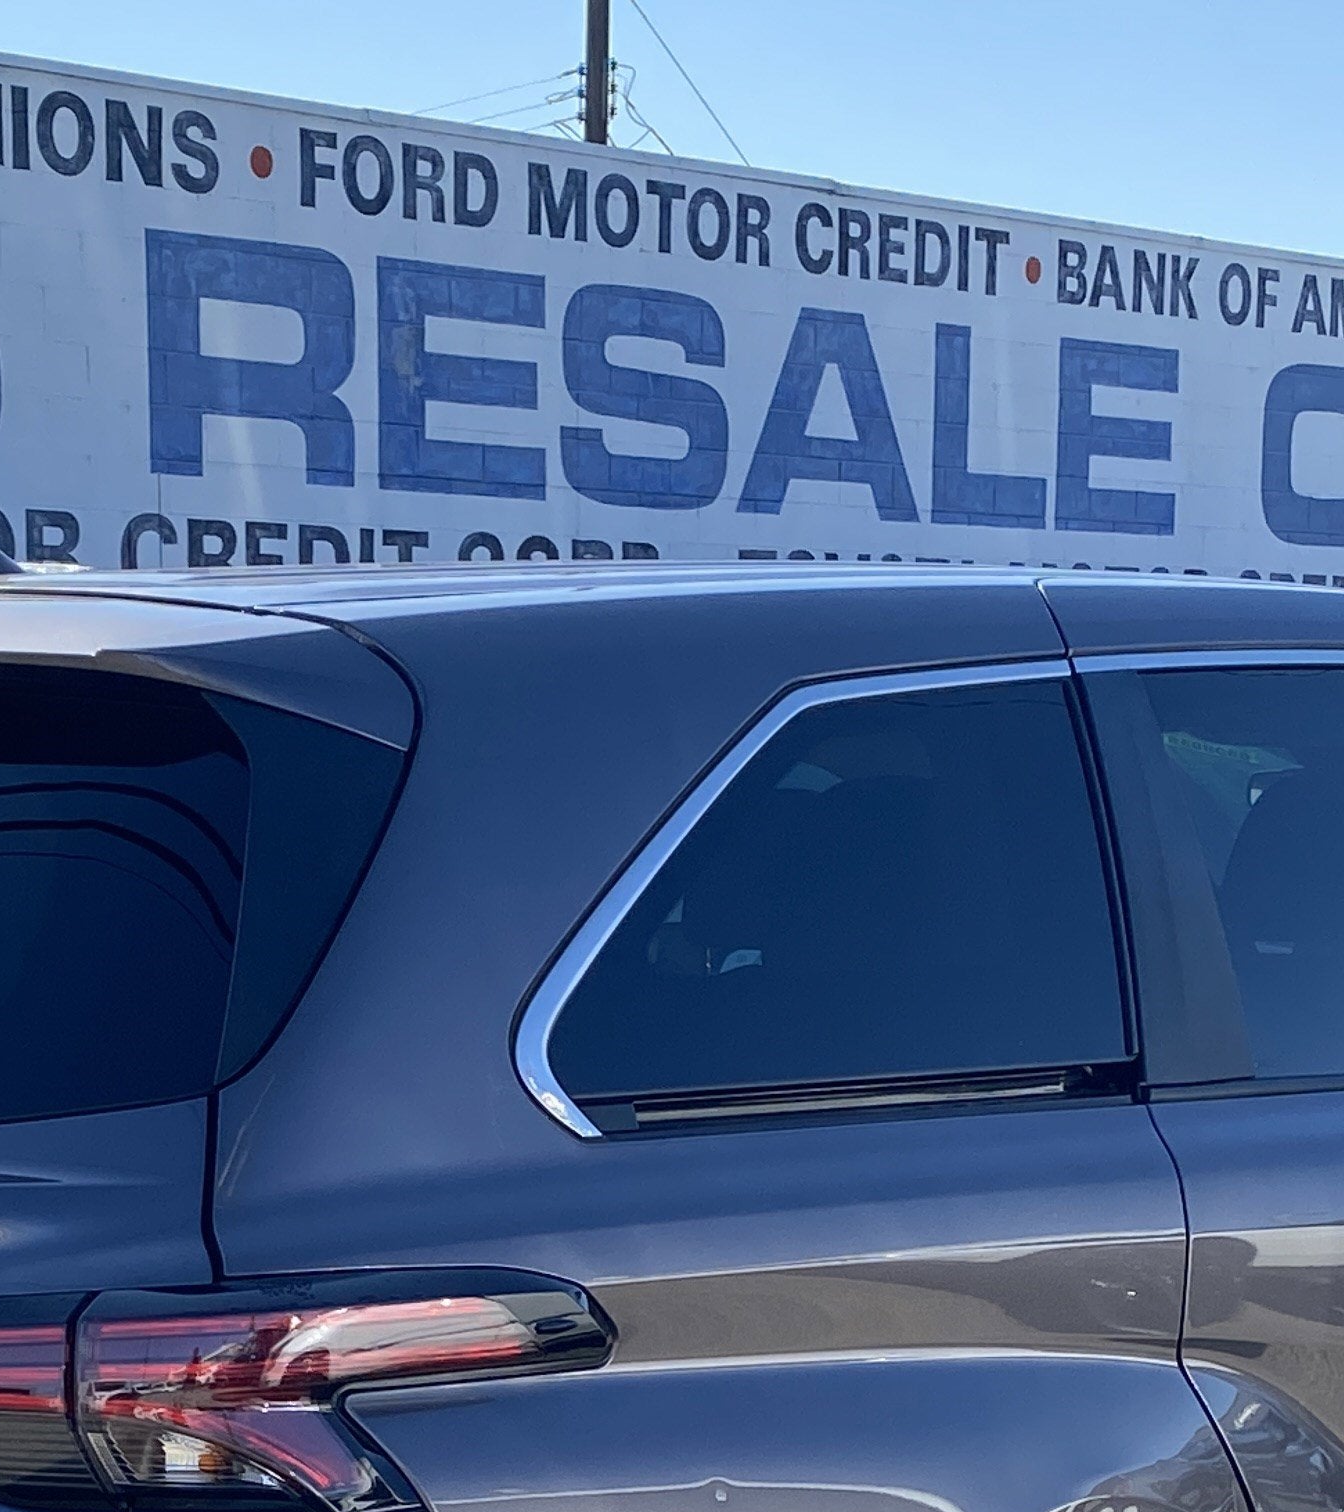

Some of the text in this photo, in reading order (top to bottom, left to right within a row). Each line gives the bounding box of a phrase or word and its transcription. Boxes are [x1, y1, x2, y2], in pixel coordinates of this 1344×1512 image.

[298, 126, 499, 227] FORD
[527, 161, 772, 268] MOTOR
[794, 202, 1011, 297] CREDIT
[1057, 237, 1200, 321] BANK
[1218, 261, 1280, 329] OF
[144, 227, 1180, 537] RESALE
